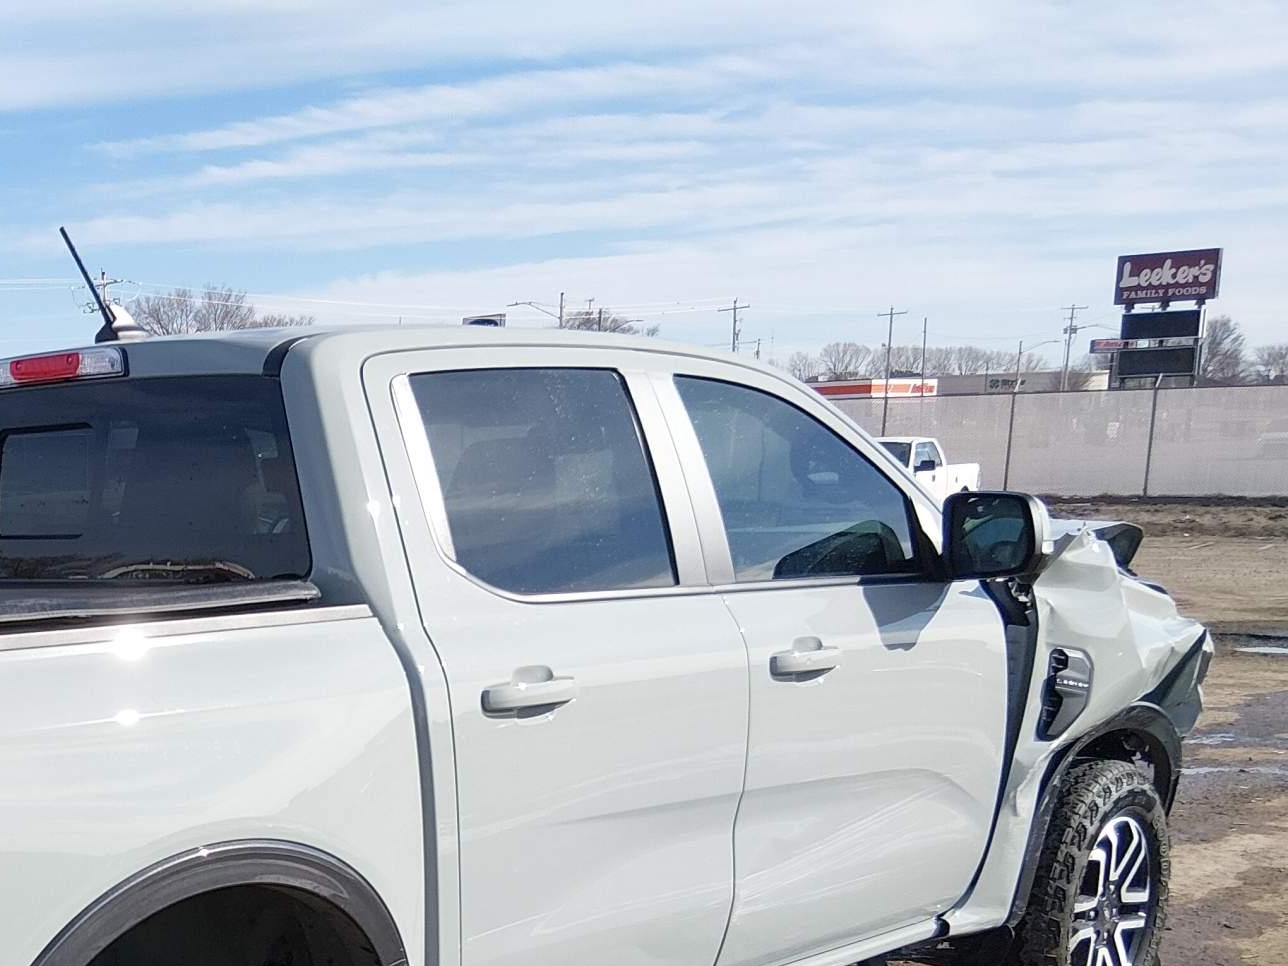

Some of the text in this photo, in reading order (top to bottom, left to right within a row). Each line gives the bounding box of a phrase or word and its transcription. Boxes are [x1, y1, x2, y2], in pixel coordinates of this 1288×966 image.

[1119, 258, 1215, 288] Leeker's
[1122, 286, 1207, 299] FAMILY FOODS
